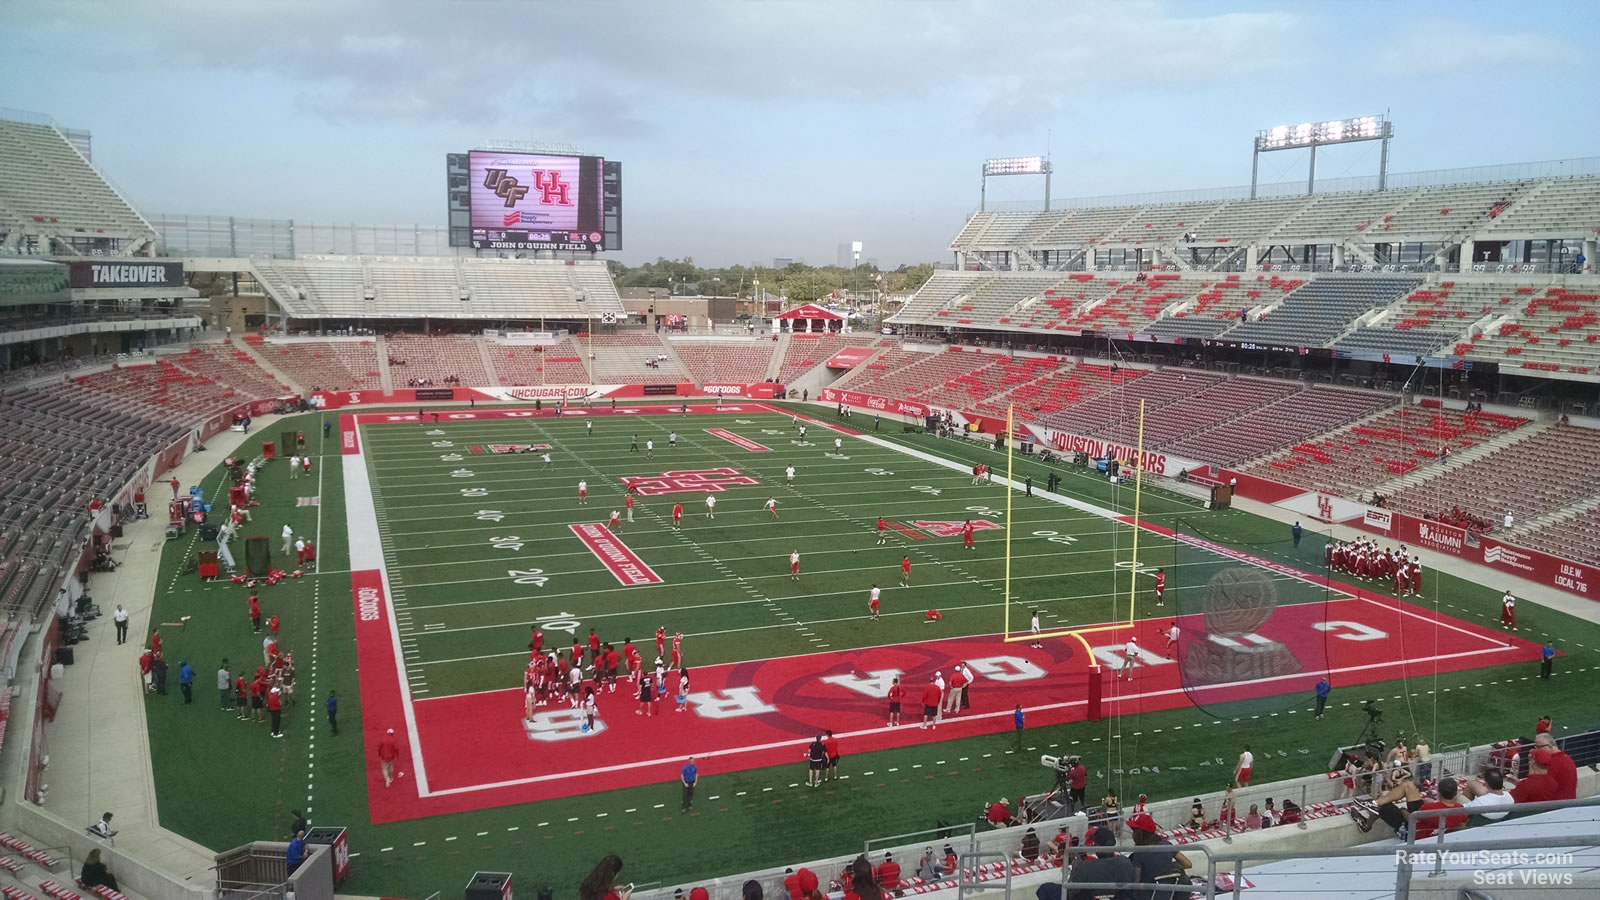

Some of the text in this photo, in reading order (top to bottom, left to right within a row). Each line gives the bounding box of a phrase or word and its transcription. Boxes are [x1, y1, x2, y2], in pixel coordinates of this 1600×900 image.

[485, 168, 571, 208] UCF UH
[91, 265, 166, 282] TAKEOVER
[511, 387, 589, 398] UHCOUGARSCOM
[704, 385, 741, 394] #GOCOOGS
[1051, 431, 1167, 474] HOUSTON COUGARS
[1317, 495, 1333, 518] UH
[1366, 509, 1390, 523] ESPN
[489, 535, 525, 551] 30
[1032, 530, 1079, 546] 20
[1420, 539, 1462, 554] ASSOCIATION
[1428, 531, 1462, 549] ALUMNI
[1501, 552, 1518, 562] Supply
[507, 568, 549, 587] 20
[617, 562, 651, 584] FIELD
[1554, 574, 1587, 593] LOCAL 716
[535, 611, 581, 634] 10
